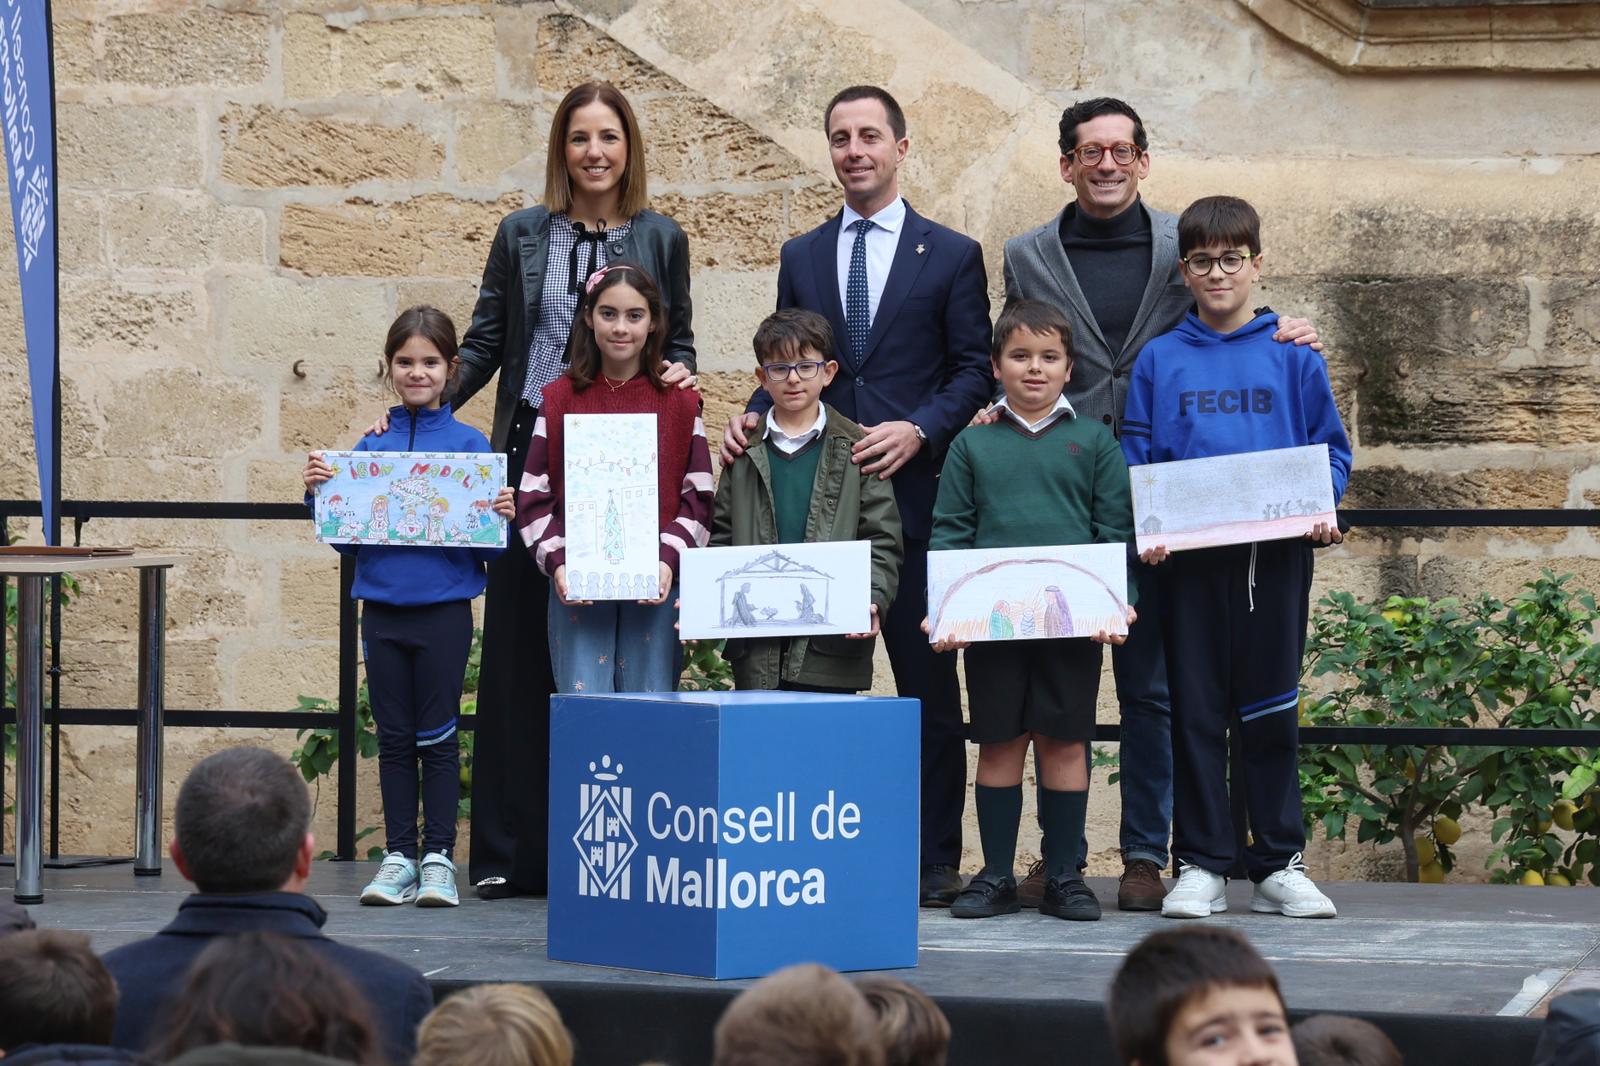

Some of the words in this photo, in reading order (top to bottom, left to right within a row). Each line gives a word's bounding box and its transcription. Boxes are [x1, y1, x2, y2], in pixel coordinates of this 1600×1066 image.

[1179, 388, 1273, 417] FECIB
[647, 791, 796, 844] Consell
[811, 790, 861, 839] de
[646, 855, 826, 909] Mallorca
